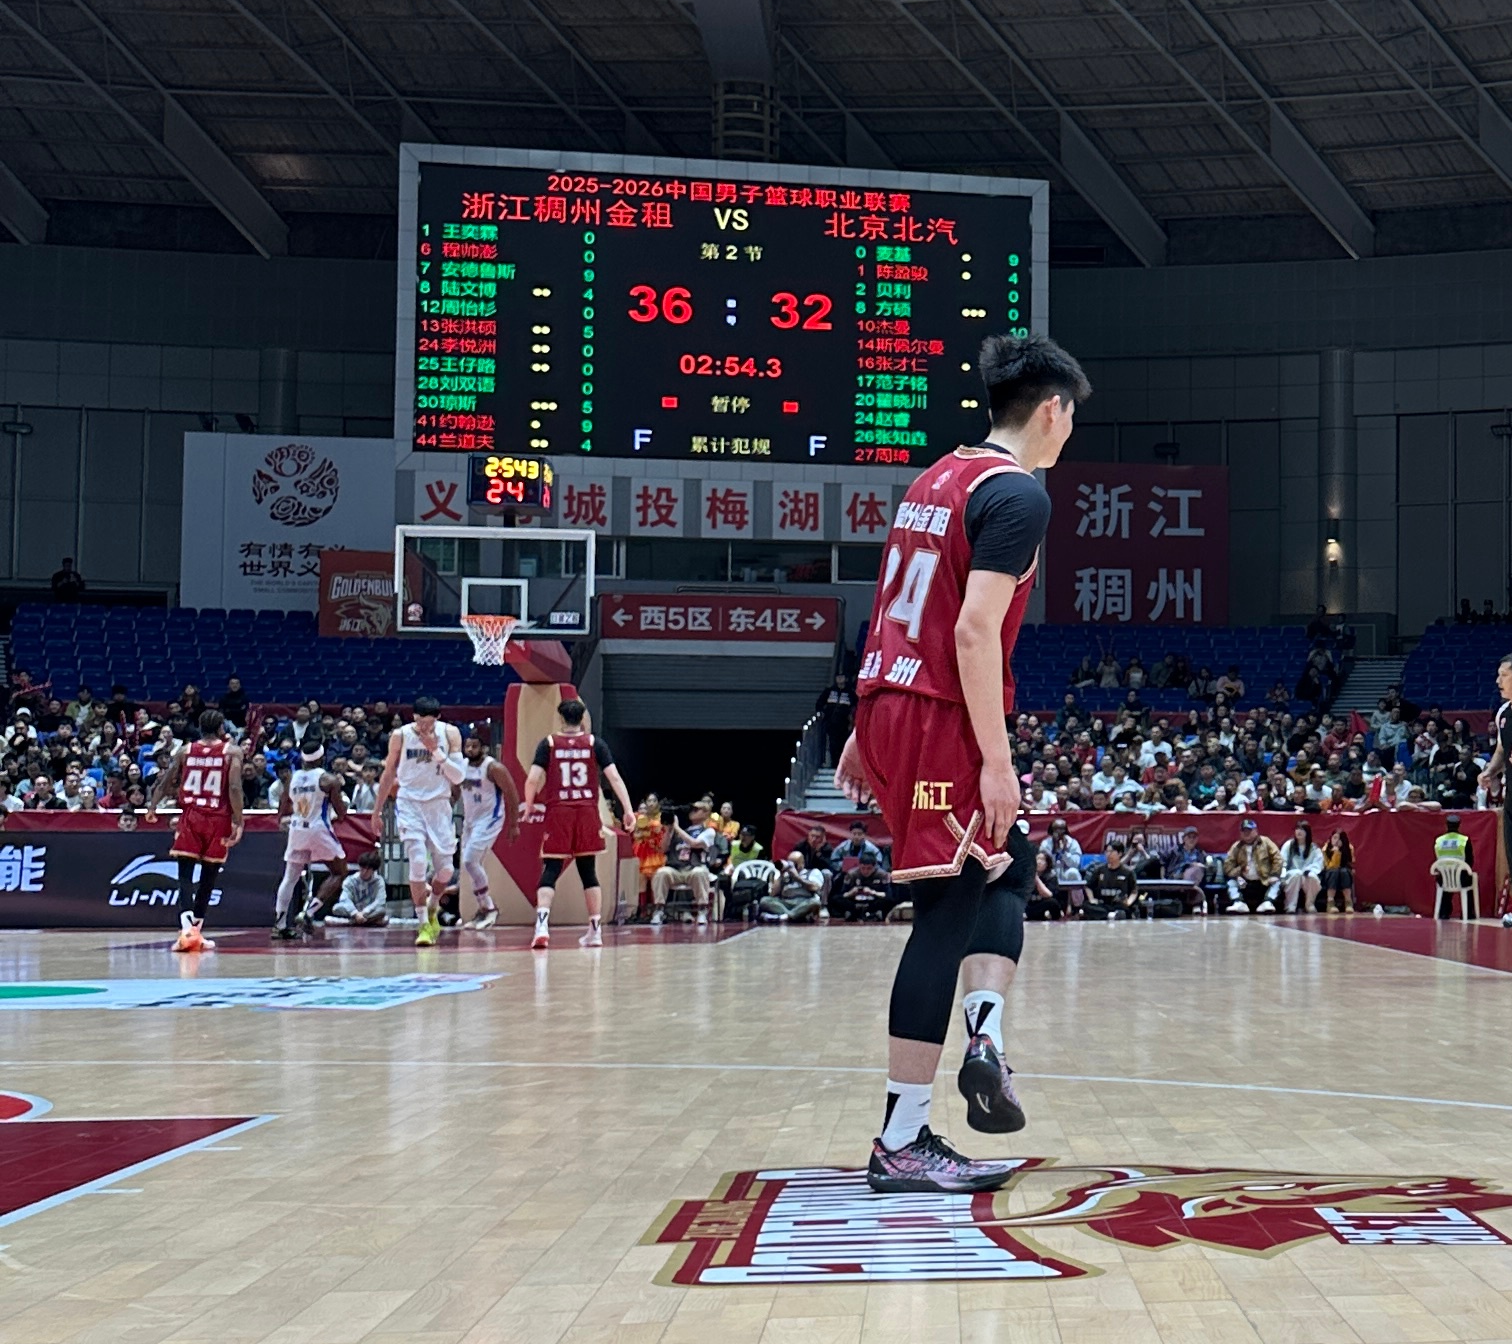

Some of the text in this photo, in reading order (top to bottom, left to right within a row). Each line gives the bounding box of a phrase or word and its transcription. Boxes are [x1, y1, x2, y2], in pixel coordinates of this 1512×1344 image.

[461, 191, 674, 229] 浙江稠州金租
[714, 207, 749, 231] VS
[421, 224, 430, 237] 1
[583, 231, 595, 245] 0
[824, 211, 959, 245] 北京北汽
[420, 242, 432, 256] 6
[583, 249, 595, 264] 0
[855, 245, 867, 259] 0
[1008, 254, 1020, 267] 9
[420, 261, 595, 283] 7 安德鲁斯 9
[857, 264, 864, 277] 1
[1008, 272, 1019, 285] 4
[419, 280, 594, 301] 8 陆文博 4
[855, 282, 1019, 303] 2 贝利 0
[420, 299, 594, 320] 12 周怡杉 0
[627, 284, 693, 325] 36
[769, 292, 833, 331] 32
[855, 300, 1019, 321] 8 方硕 0
[421, 319, 440, 333] 13
[582, 325, 594, 339] 5
[857, 319, 876, 332] 10
[875, 319, 911, 336] 杰曼
[418, 338, 439, 351] 24
[582, 344, 594, 358] 0
[857, 338, 874, 350] 14
[417, 357, 594, 376] 25 王仔路 0
[679, 354, 783, 379] 02:54.3
[857, 356, 929, 373] 16 张才仁
[417, 376, 439, 390] 28
[581, 381, 593, 395] 0
[856, 374, 928, 391] 17 范子铭
[417, 395, 439, 409] 30
[581, 400, 593, 414] 5
[710, 395, 751, 414] 暂停
[854, 392, 927, 410] 20 翟晓川
[416, 414, 593, 433] 41 约翰逊 9
[854, 411, 874, 425] 24
[416, 433, 592, 452] 44 兰道夫 4
[633, 428, 653, 451] F
[690, 435, 772, 456] 累计犯规
[808, 435, 828, 457] F
[854, 430, 875, 443] 26
[854, 448, 875, 462] 27
[485, 478, 525, 504] 24
[420, 479, 888, 534] 义城投梅湖体
[1074, 483, 1206, 540] 浙江
[1074, 566, 1204, 623] 稠州
[639, 605, 802, 634] 西5区 东4区
[182, 769, 223, 796] 44
[559, 761, 589, 788] 13
[0, 844, 47, 893] 能
[108, 888, 224, 907] LI-NIG
